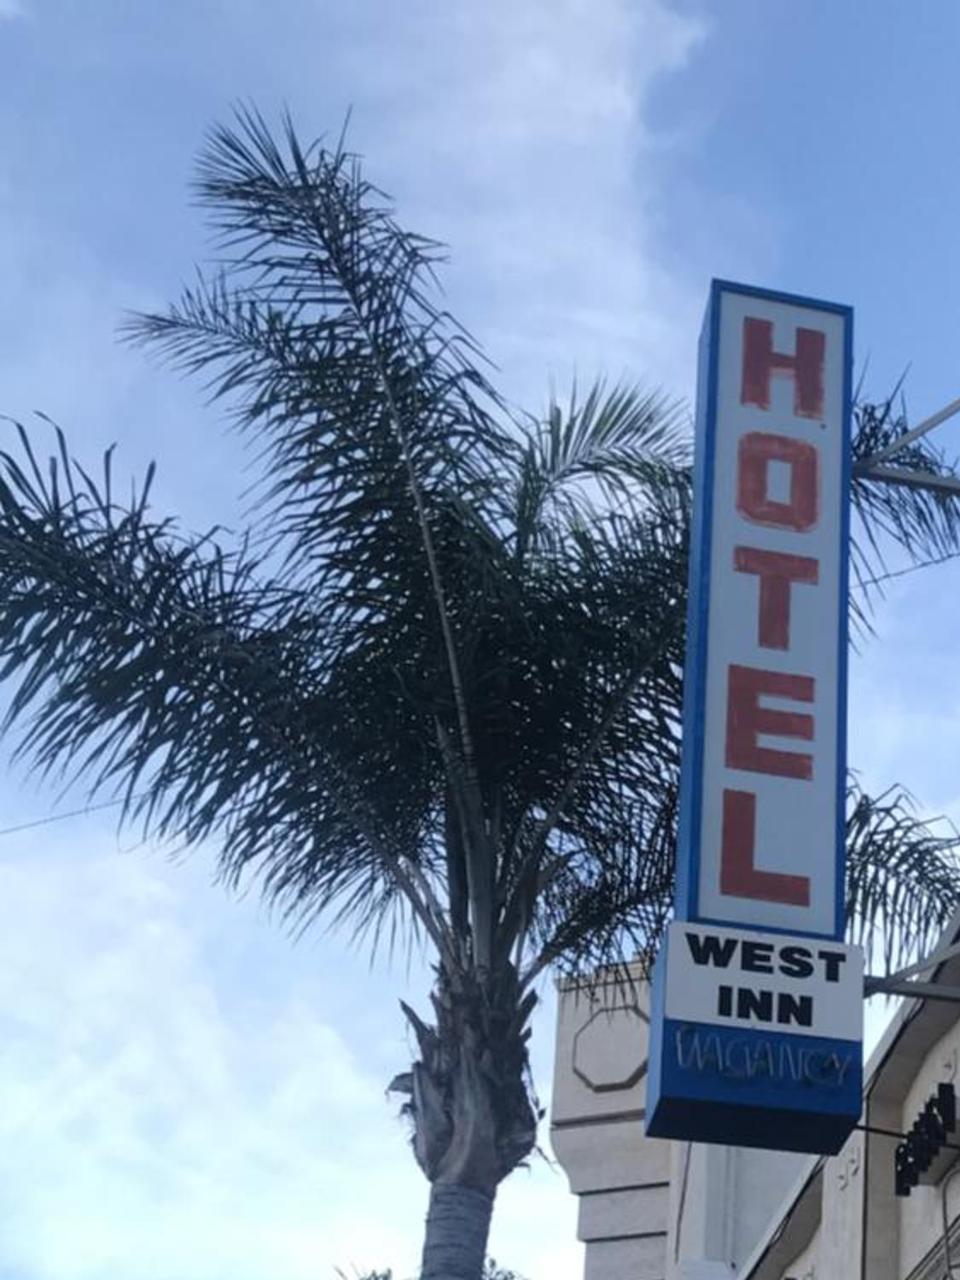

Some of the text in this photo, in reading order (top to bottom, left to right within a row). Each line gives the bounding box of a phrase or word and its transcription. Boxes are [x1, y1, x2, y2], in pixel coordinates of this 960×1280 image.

[719, 315, 826, 908] HOTEL
[684, 932, 847, 983] WEST
[717, 985, 814, 1027] INN
[676, 1024, 851, 1087] VACANCY
